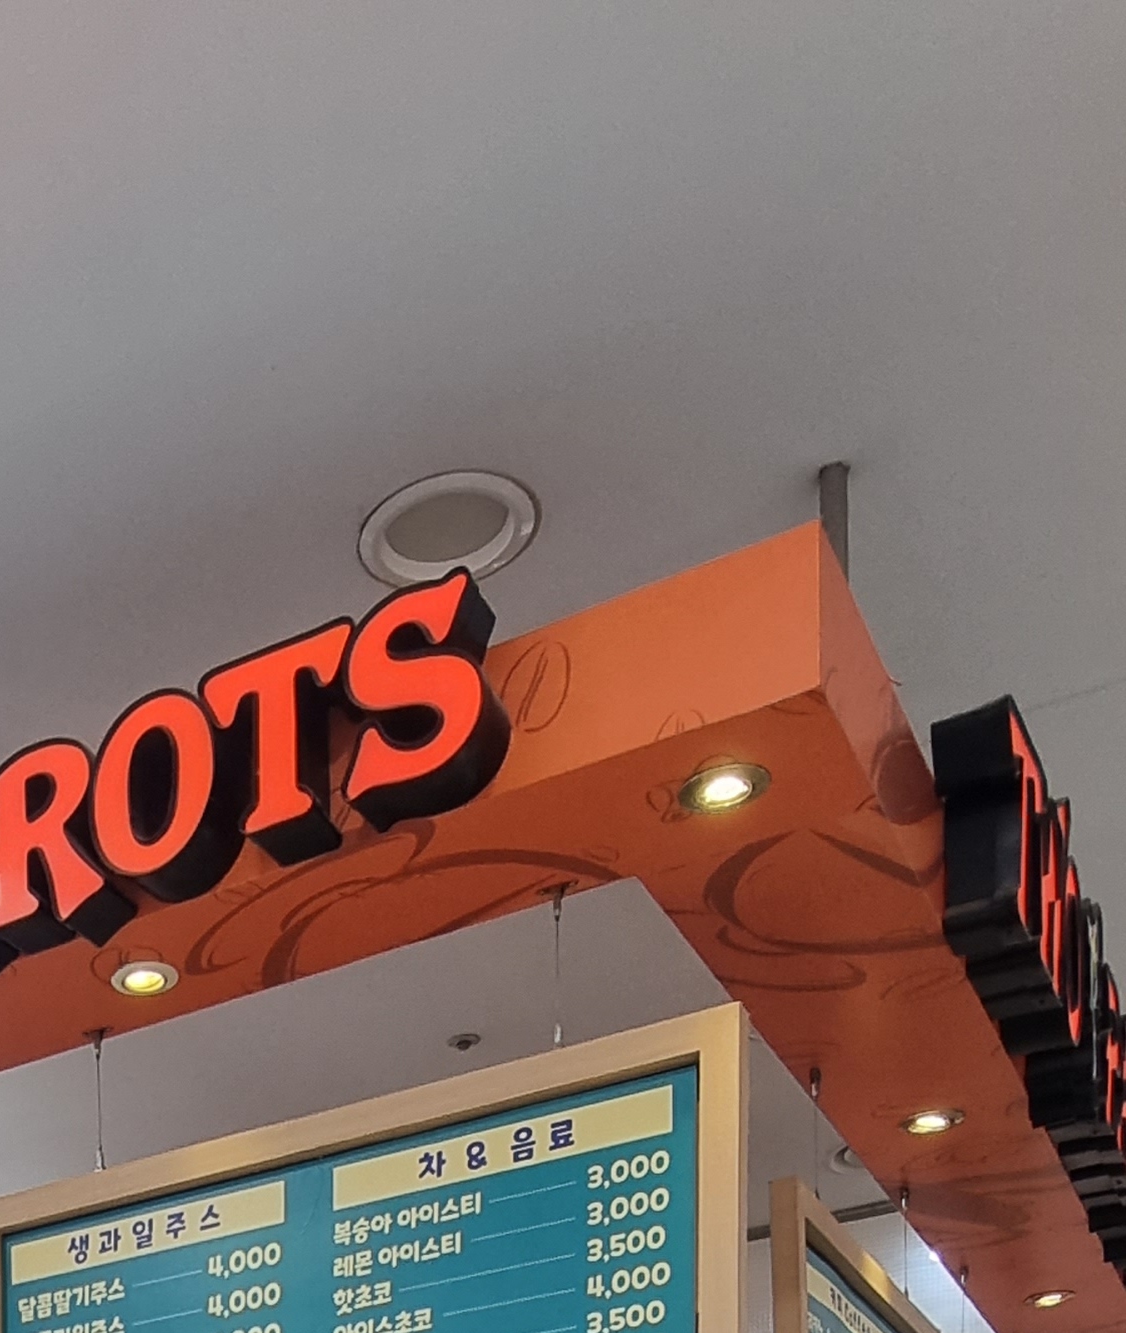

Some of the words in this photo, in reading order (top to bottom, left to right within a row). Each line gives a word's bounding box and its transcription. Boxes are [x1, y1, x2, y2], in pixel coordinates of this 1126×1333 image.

[418, 1151, 446, 1180] 차
[466, 1141, 487, 1170] &
[511, 1119, 575, 1162] 음료
[333, 1212, 392, 1245] 복숭아
[398, 1192, 481, 1230] 아이스티
[587, 1150, 670, 1189] 3,000
[333, 1249, 373, 1278] 레몬
[378, 1231, 461, 1268] 아이스티
[587, 1187, 670, 1226] 3,000
[18, 1278, 125, 1323] 달콤딸기주스
[208, 1242, 281, 1279] 4,000
[208, 1282, 281, 1318] 4,000
[333, 1281, 392, 1316] 핫초코
[587, 1225, 666, 1263] 3,500
[587, 1262, 671, 1299] 4,000
